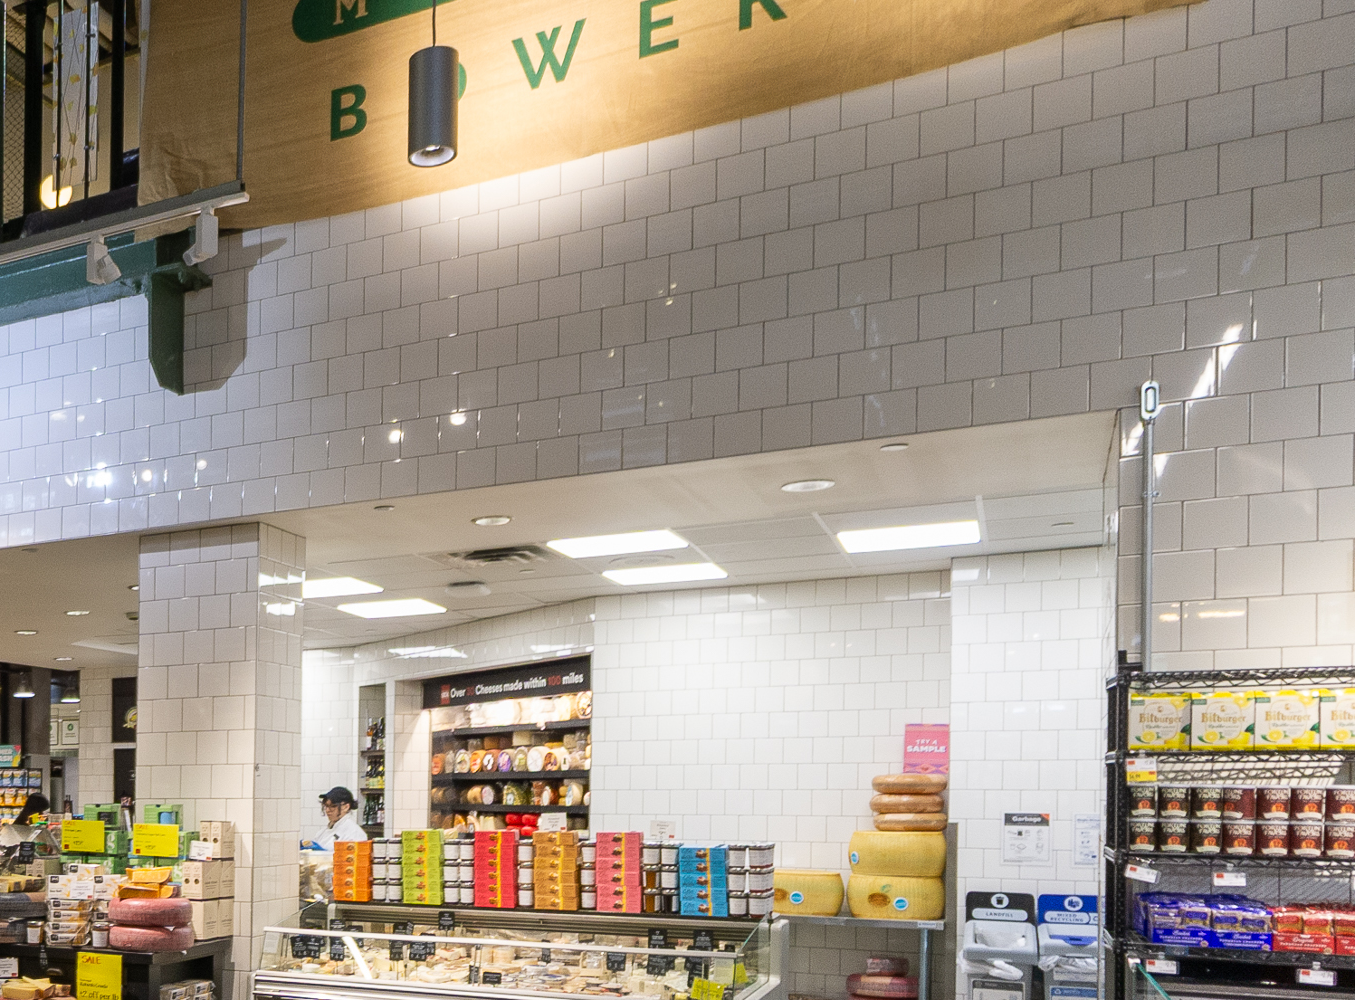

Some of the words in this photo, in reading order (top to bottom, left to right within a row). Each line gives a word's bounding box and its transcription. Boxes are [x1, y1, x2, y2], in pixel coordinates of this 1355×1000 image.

[450, 688, 466, 698] Over
[475, 684, 503, 697] Cheeses
[503, 679, 523, 692] made
[523, 676, 547, 689] within
[562, 672, 584, 685] miles
[1201, 712, 1246, 724] Bitburger
[1265, 711, 1311, 723] Bitburger
[907, 745, 947, 753] SAMPLE
[1011, 815, 1042, 823] Garbage
[81, 955, 102, 965] SALE
